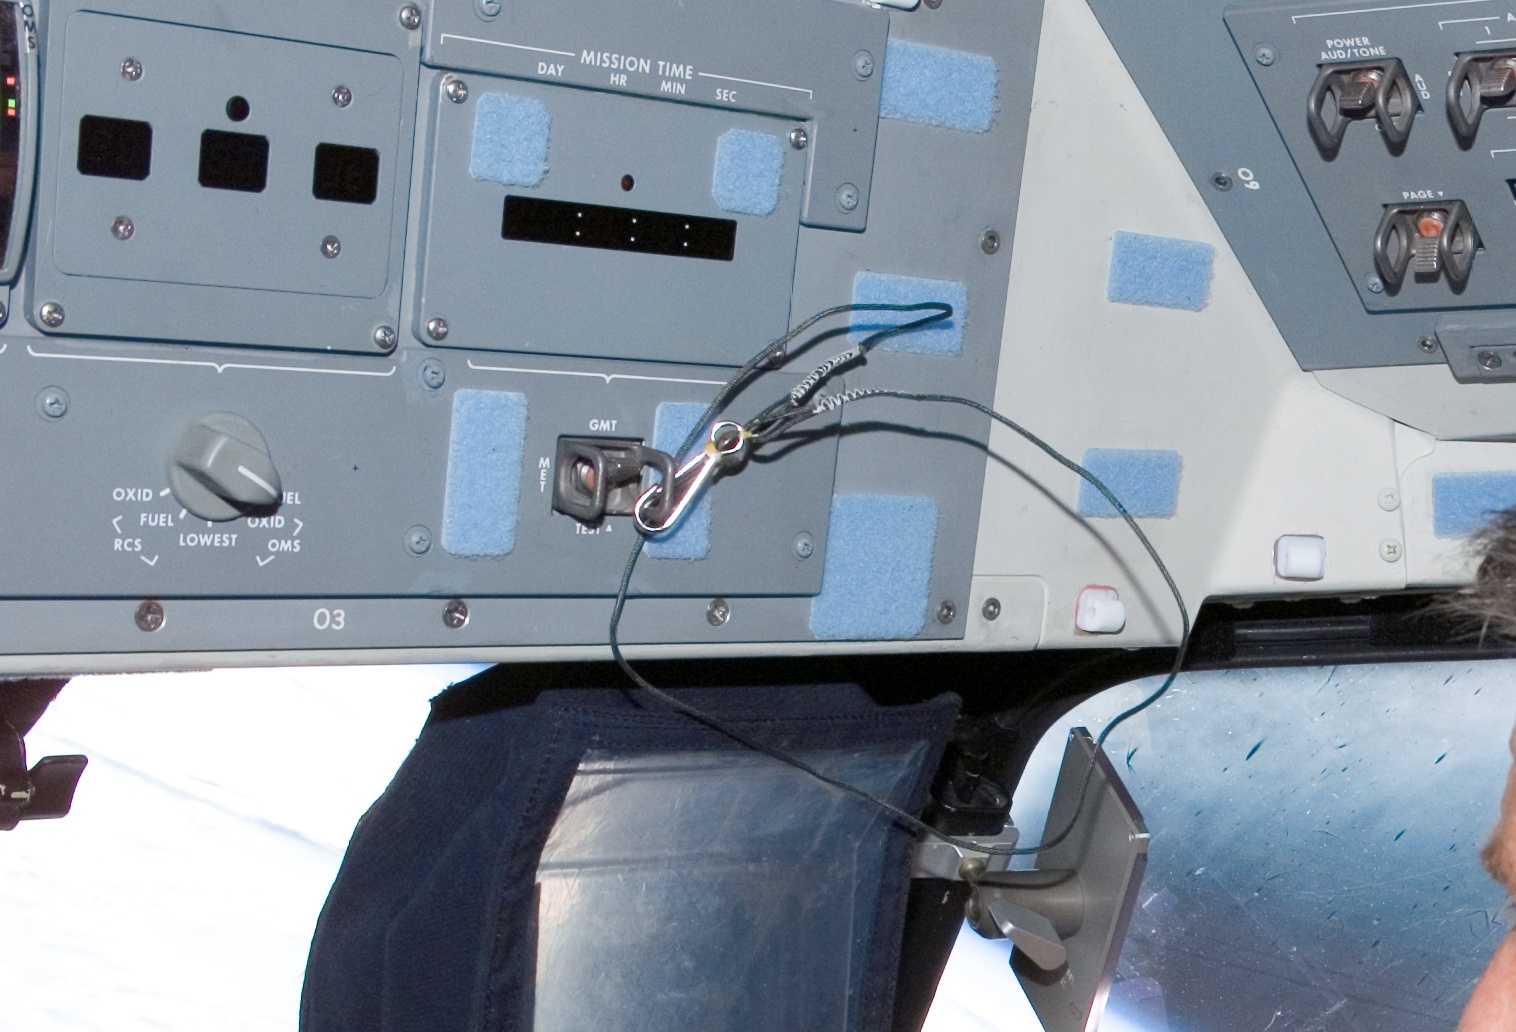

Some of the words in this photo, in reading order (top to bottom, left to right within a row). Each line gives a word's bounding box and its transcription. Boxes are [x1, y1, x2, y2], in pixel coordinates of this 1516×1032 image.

[1326, 36, 1371, 49] POWER
[1321, 46, 1387, 60] AUD/TONE
[580, 49, 651, 74] MISSION
[657, 61, 693, 80] TIME
[537, 61, 565, 77] DAY
[610, 73, 628, 87] HR
[660, 80, 686, 95] MIN
[715, 88, 738, 103] SEC
[1414, 73, 1431, 100] AUD
[1402, 189, 1435, 200] PAGE
[589, 419, 618, 432] GMT
[538, 457, 550, 493] MET
[112, 487, 153, 502] OXID
[140, 513, 174, 527] FUEL
[247, 515, 285, 529] OXID
[114, 538, 142, 552] RCS
[179, 533, 238, 548] LOWEST
[267, 539, 301, 553] OMS
